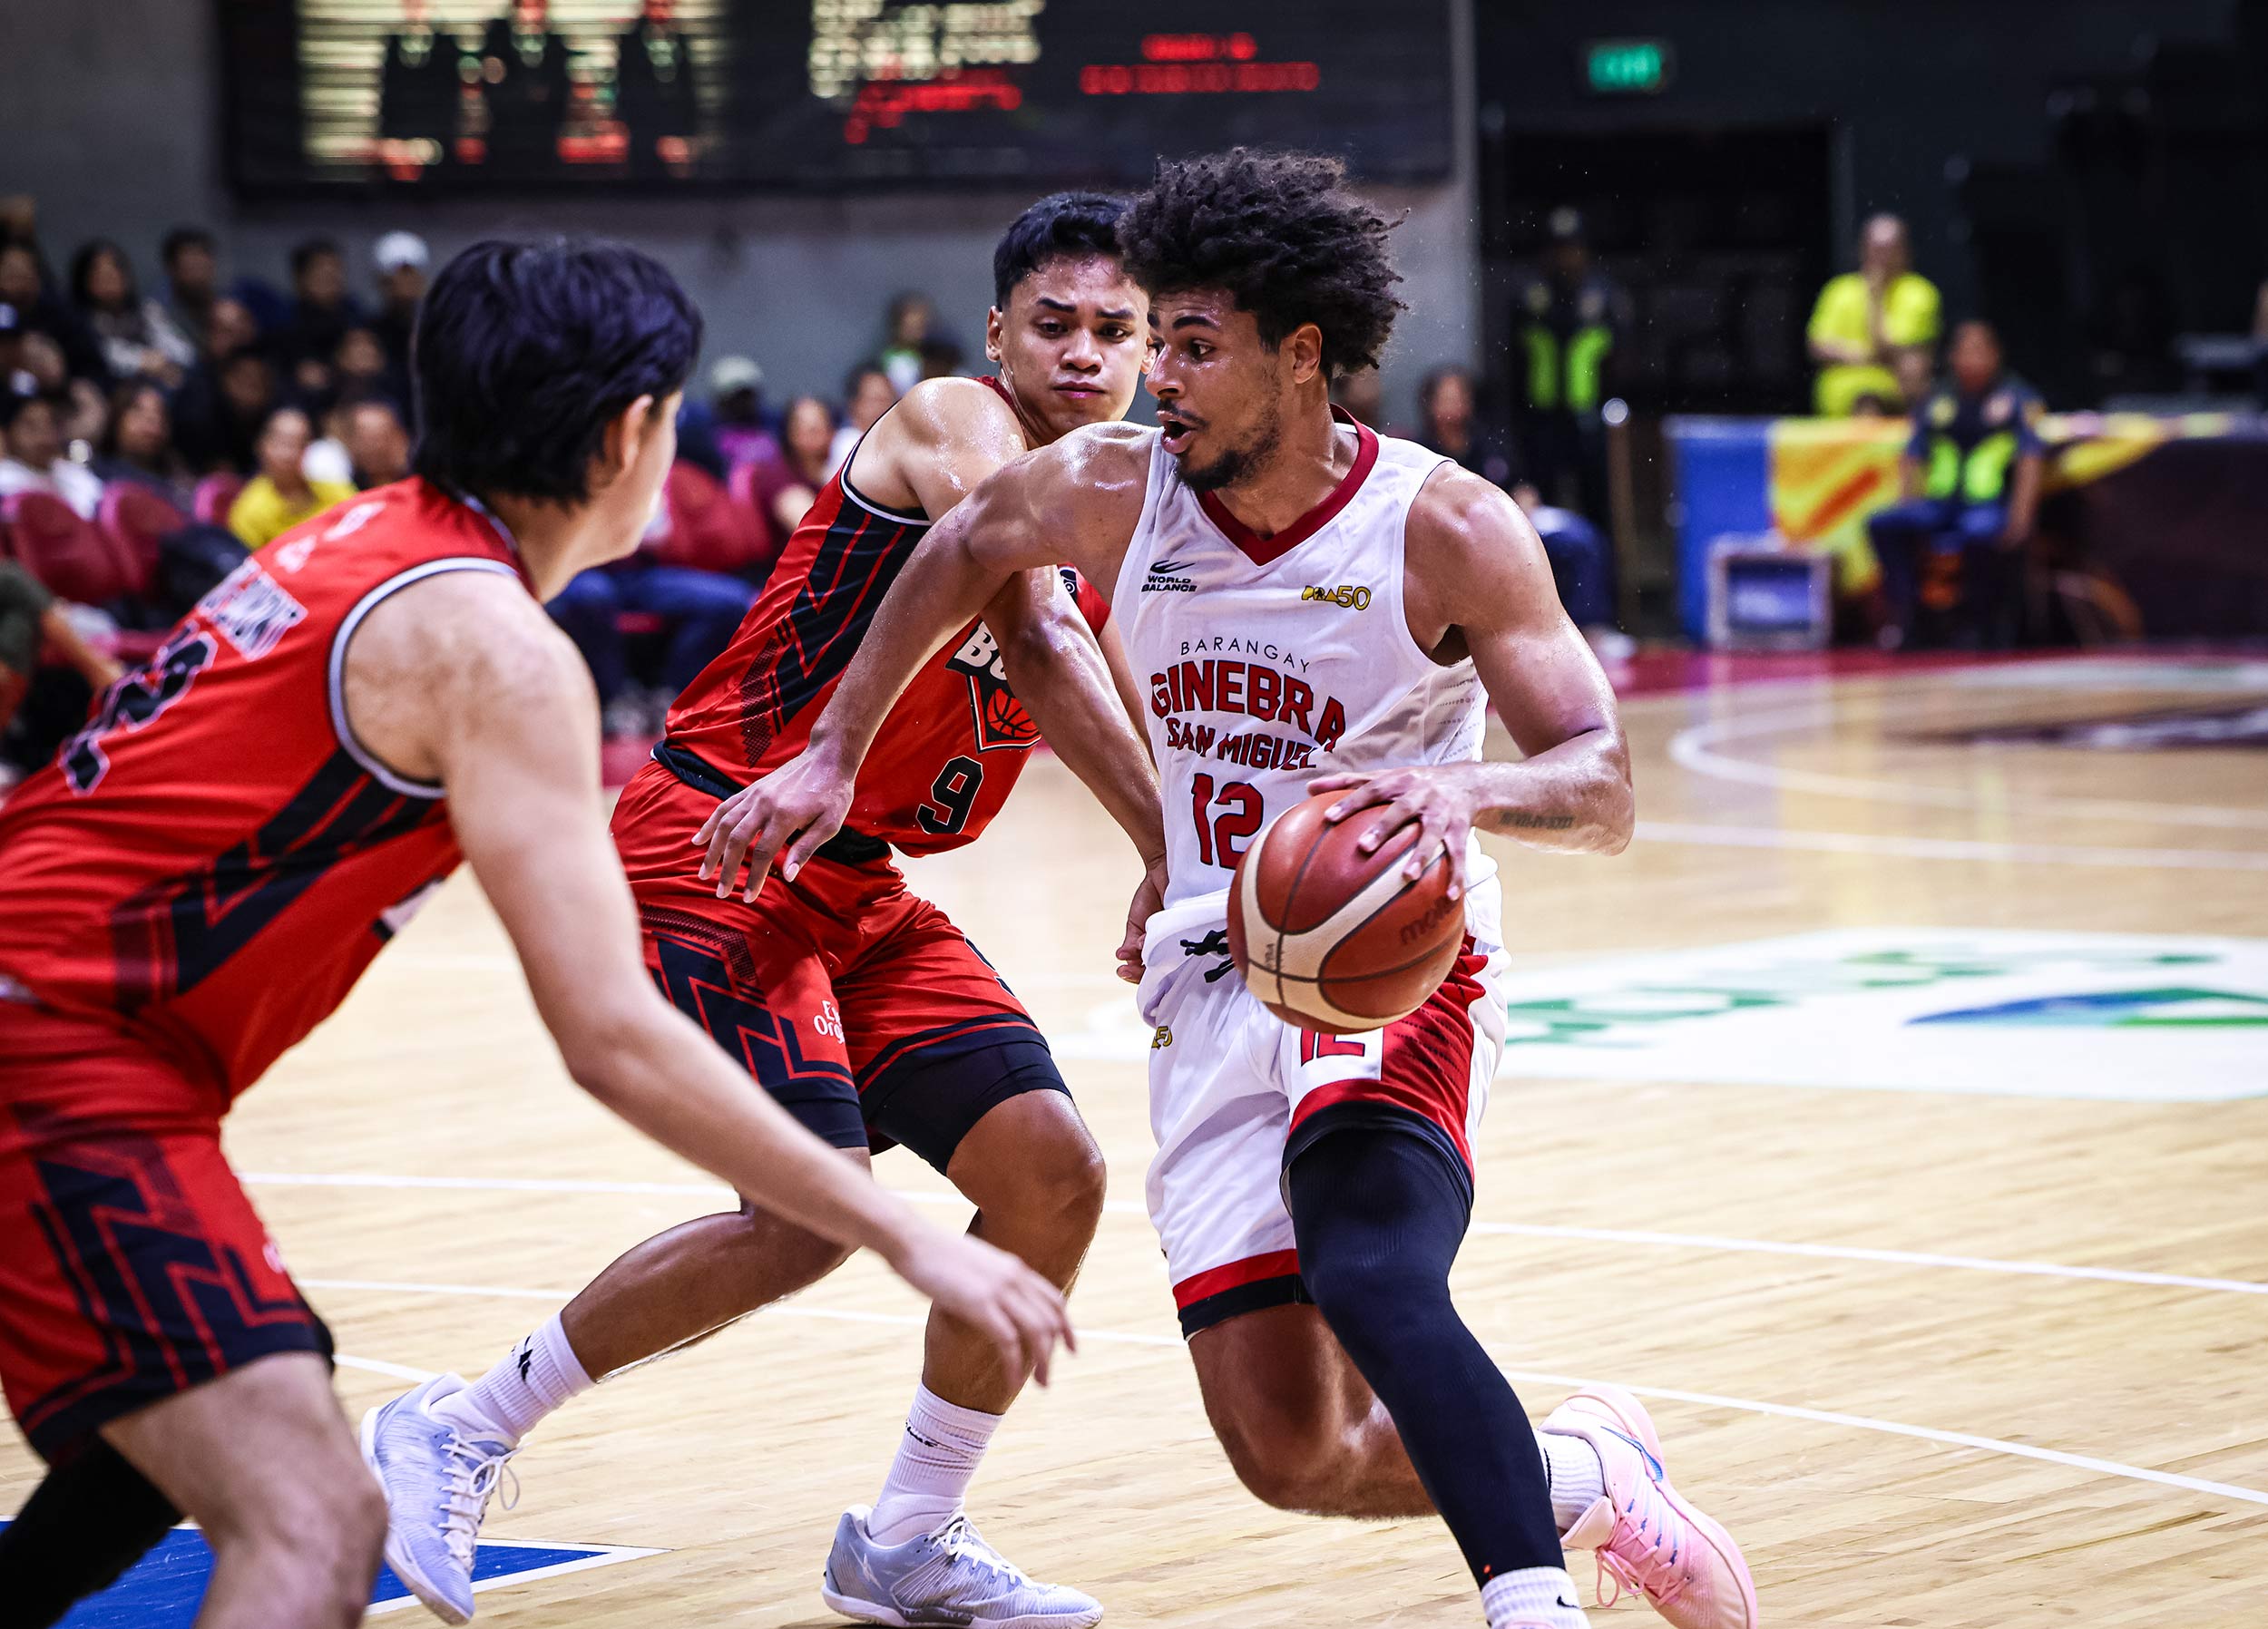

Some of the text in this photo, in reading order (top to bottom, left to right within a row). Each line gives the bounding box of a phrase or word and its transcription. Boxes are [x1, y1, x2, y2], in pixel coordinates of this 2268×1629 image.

[1140, 583, 1198, 592] BALANCE
[1148, 575, 1191, 583] WORLD
[1180, 637, 1310, 673] BARANGAY
[1149, 659, 1346, 753] GINEBRA
[1166, 717, 1318, 771] SAN MIGUEL
[915, 755, 984, 835] 9
[1191, 772, 1265, 871] 12
